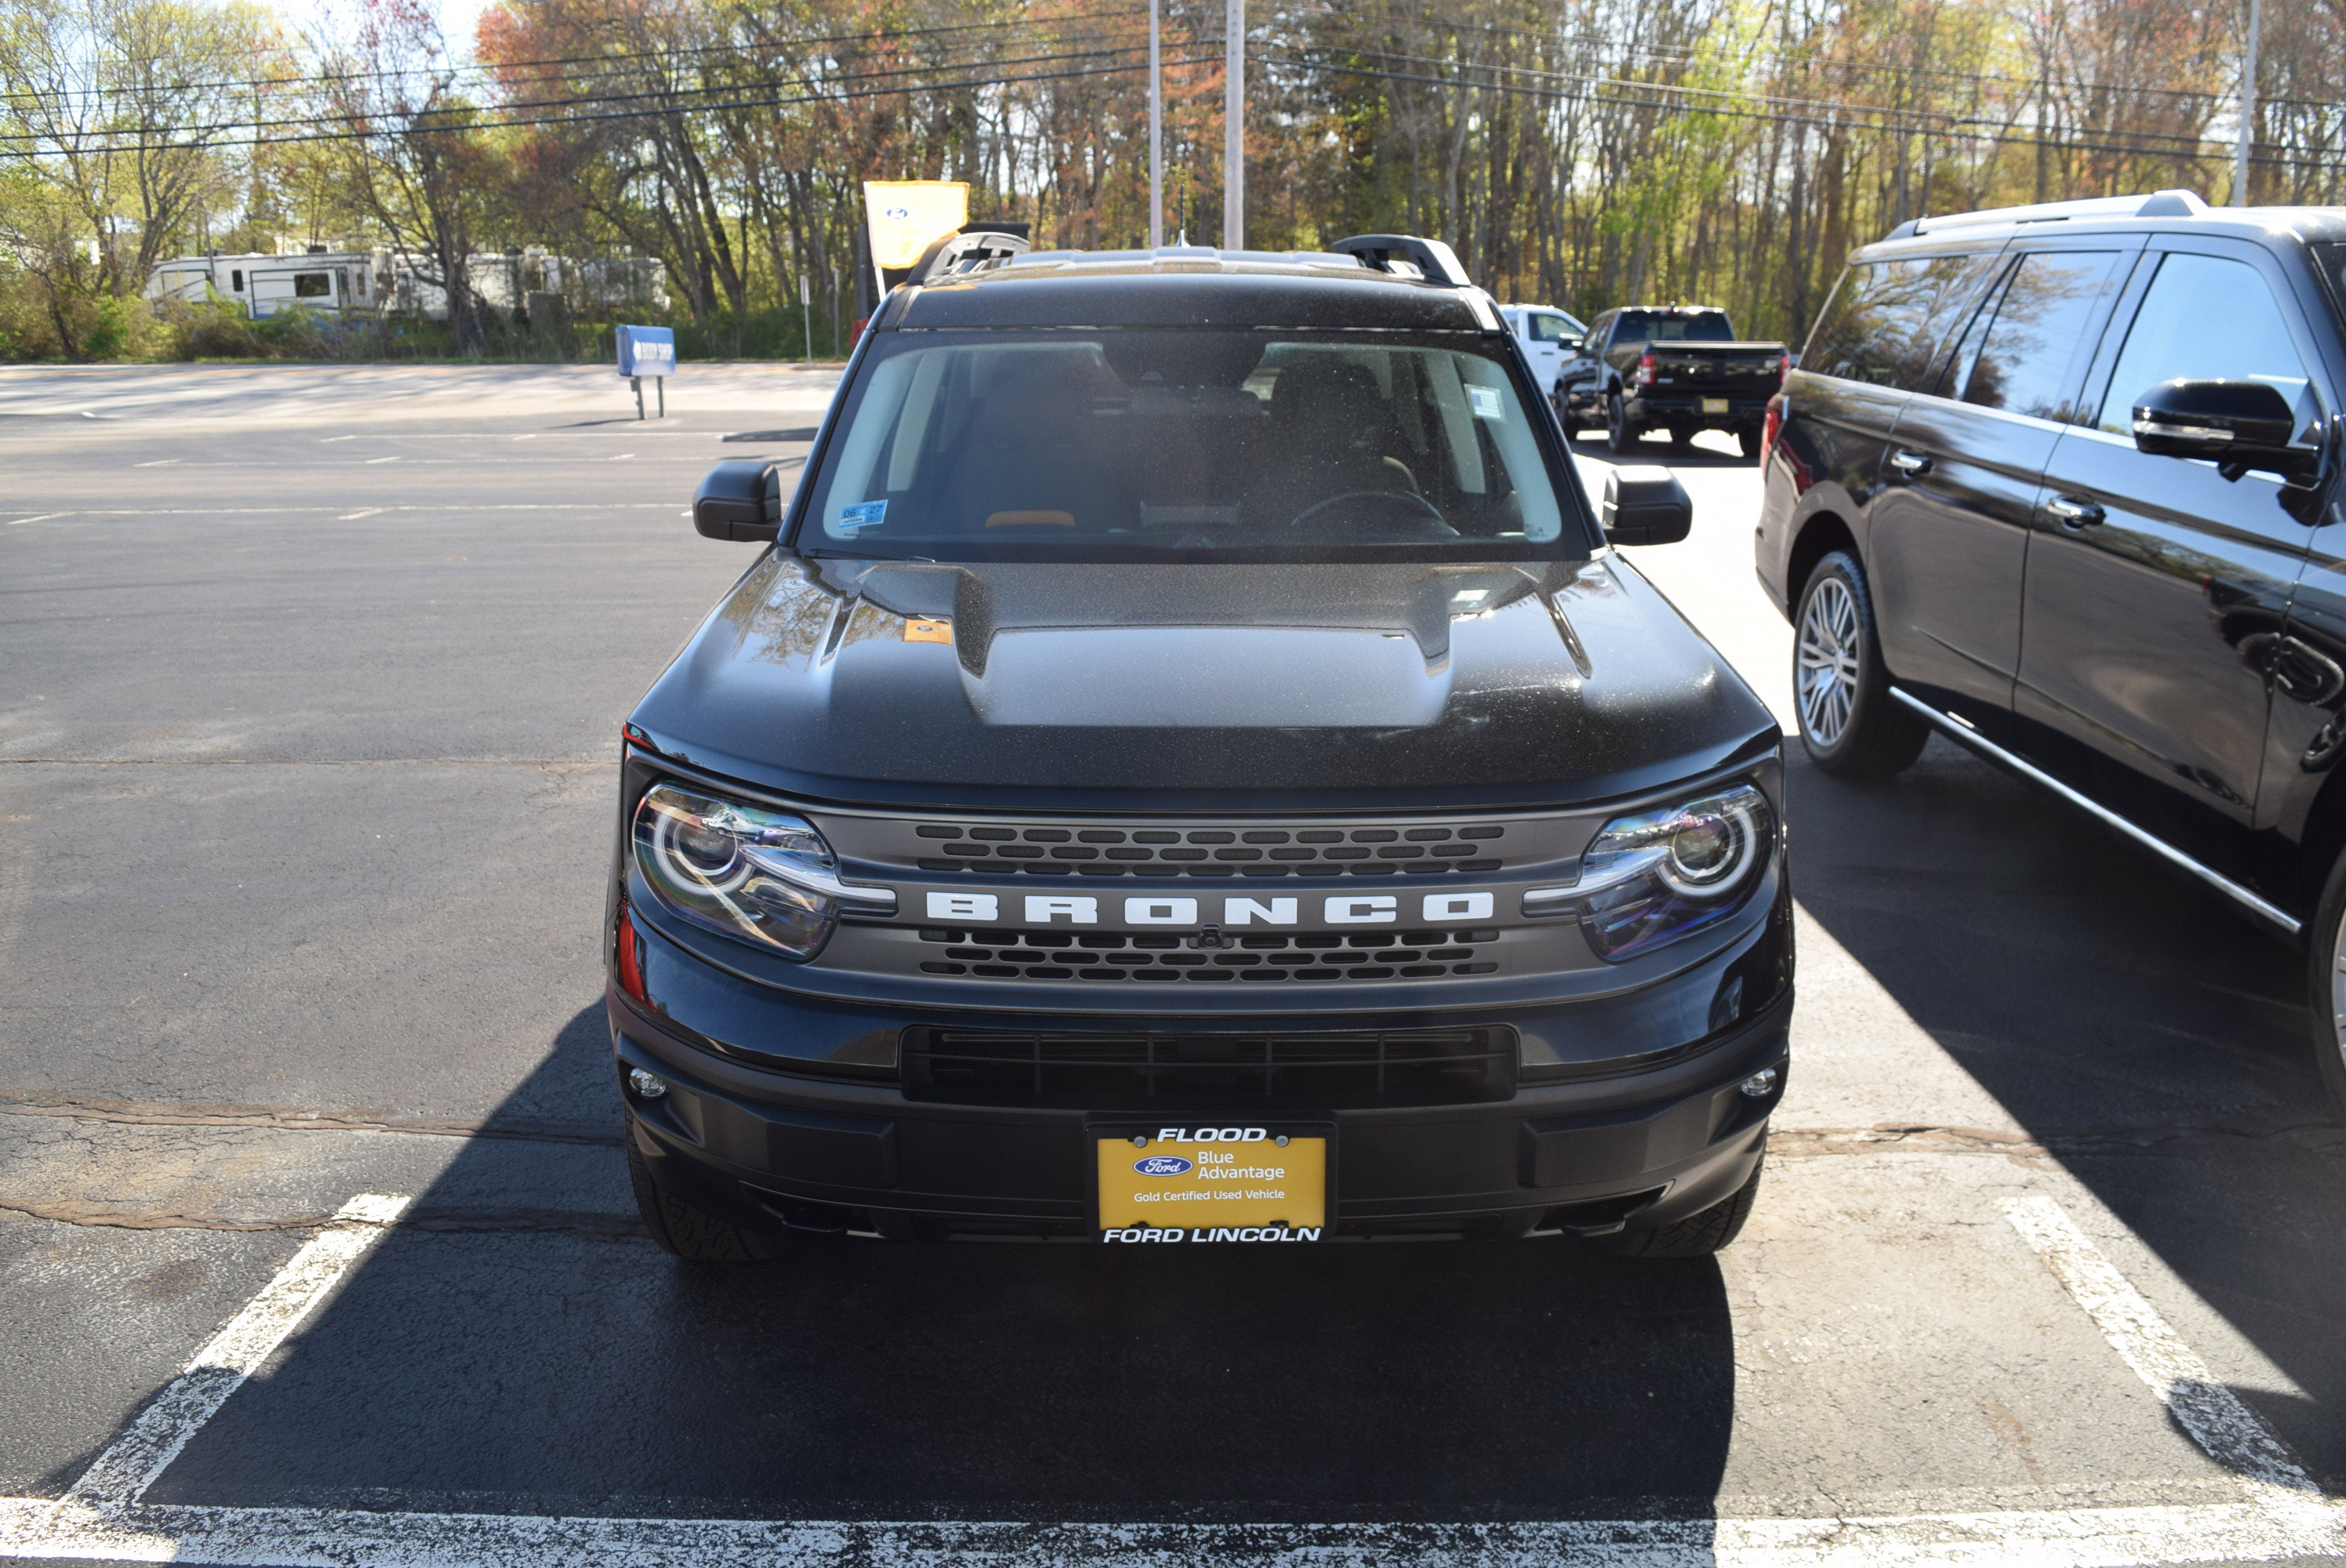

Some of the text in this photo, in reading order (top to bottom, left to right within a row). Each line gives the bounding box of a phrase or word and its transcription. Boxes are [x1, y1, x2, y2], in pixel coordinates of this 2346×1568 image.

[870, 504, 882, 514] 27
[927, 891, 1494, 925] BRONCO
[1157, 1127, 1266, 1143] FLOOD
[1198, 1151, 1234, 1164] Blue
[1145, 1159, 1182, 1173] Ford
[1198, 1166, 1285, 1181] Advantage
[1134, 1189, 1285, 1202] Gold Certified Used Vehicle
[1103, 1227, 1321, 1243] FORD LINCOLN
